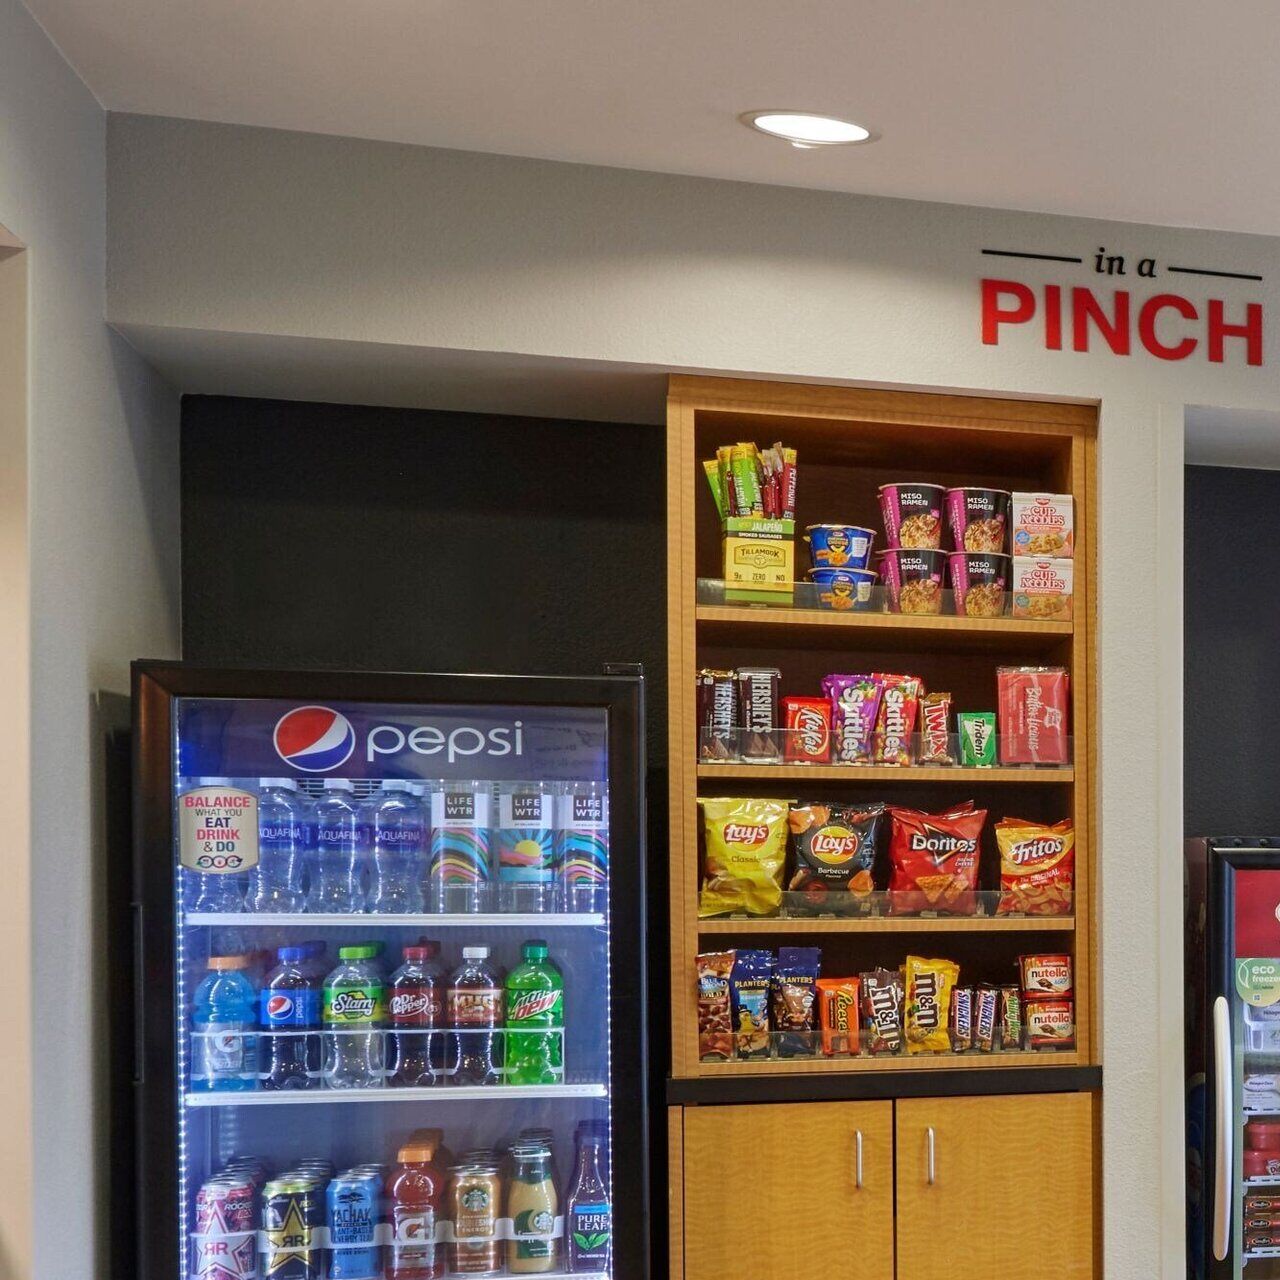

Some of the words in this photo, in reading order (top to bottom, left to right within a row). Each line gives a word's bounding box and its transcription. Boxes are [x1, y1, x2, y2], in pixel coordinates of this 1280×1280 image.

[1095, 247, 1126, 275] in
[1137, 258, 1157, 278] a
[981, 278, 1263, 367] PINCH
[1031, 506, 1056, 516] CUP
[1020, 514, 1065, 526] NOODLES
[741, 548, 780, 558] TILLAMOOK
[901, 563, 928, 571] RAMEN
[1031, 570, 1056, 580] CUP
[1020, 578, 1065, 589] NOODLES
[752, 674, 772, 733] HERSHEY'S
[714, 682, 732, 739] HERSHEY'S
[842, 687, 864, 761] Skittles
[884, 689, 905, 758] Skittles
[924, 701, 949, 757] TWIX
[367, 720, 524, 763] pepsi
[974, 719, 984, 757] Trident
[184, 796, 251, 808] BALANCE
[447, 797, 473, 805] LIFE
[195, 808, 221, 817] WHAT
[223, 808, 242, 817] YOU
[447, 807, 473, 815] WTR
[514, 808, 541, 816] WTR
[576, 809, 601, 817] WTR
[205, 817, 231, 828] EAT
[196, 829, 240, 841] DRINK
[725, 824, 768, 844] Lay's
[203, 841, 213, 852] &
[216, 841, 235, 852] DO
[814, 835, 855, 855] Lay's
[912, 835, 976, 852] Doritos
[1011, 838, 1063, 864] Fritos
[731, 855, 761, 863] Classic
[817, 867, 850, 875] Barbecue
[1032, 968, 1067, 978] nutella
[1252, 966, 1275, 974] eco
[735, 980, 771, 988] PLANTERS
[779, 976, 813, 984] PLANTERS
[401, 994, 415, 1003] Dr
[390, 997, 426, 1014] Pepper
[957, 990, 970, 1038] SNICKERS
[978, 993, 995, 1039] SNICKERS
[1034, 1014, 1070, 1024] nutella
[577, 1215, 608, 1223] PURE
[577, 1222, 607, 1231] LEAF
